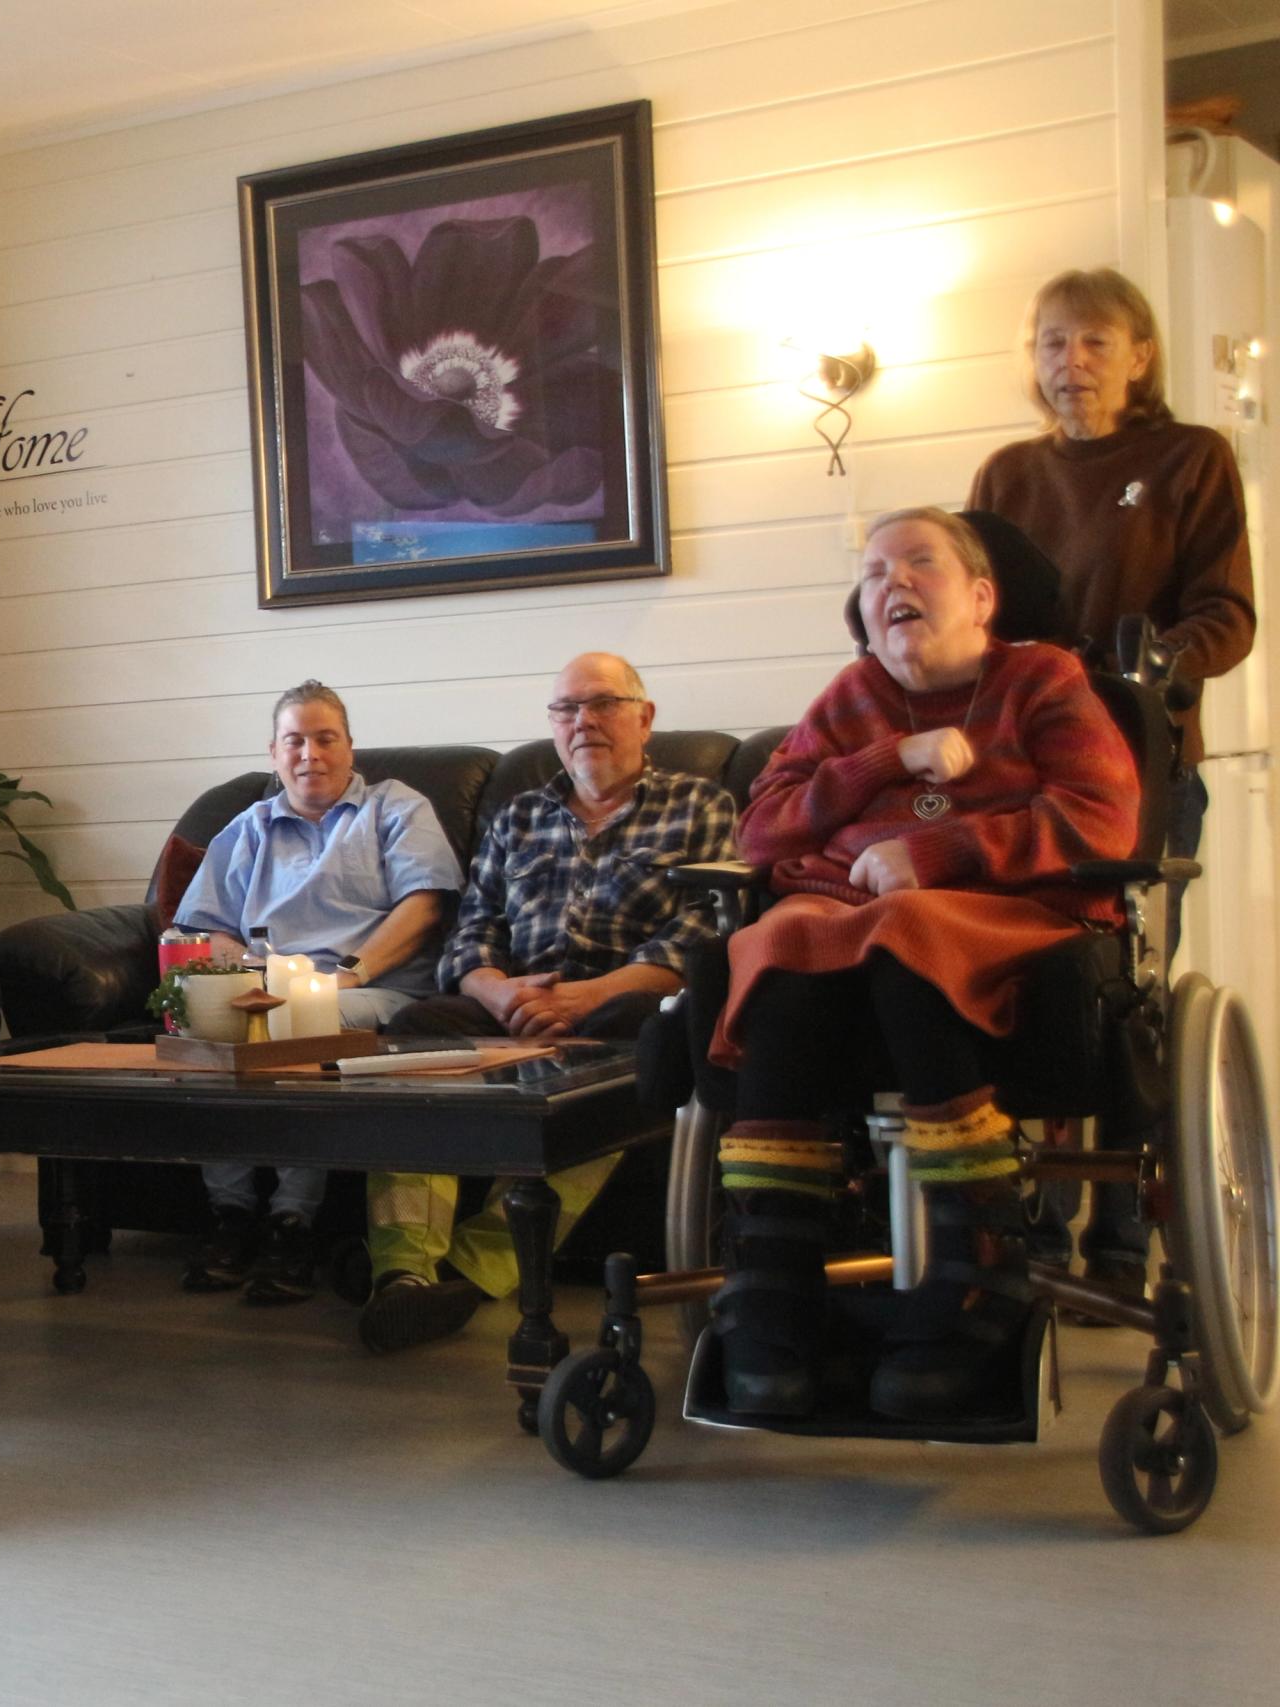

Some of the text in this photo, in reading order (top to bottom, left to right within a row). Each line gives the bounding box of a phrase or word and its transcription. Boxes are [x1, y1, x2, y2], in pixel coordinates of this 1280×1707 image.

[3, 500, 31, 517] who
[32, 497, 58, 513] love
[59, 497, 83, 515] you
[85, 490, 109, 506] live
